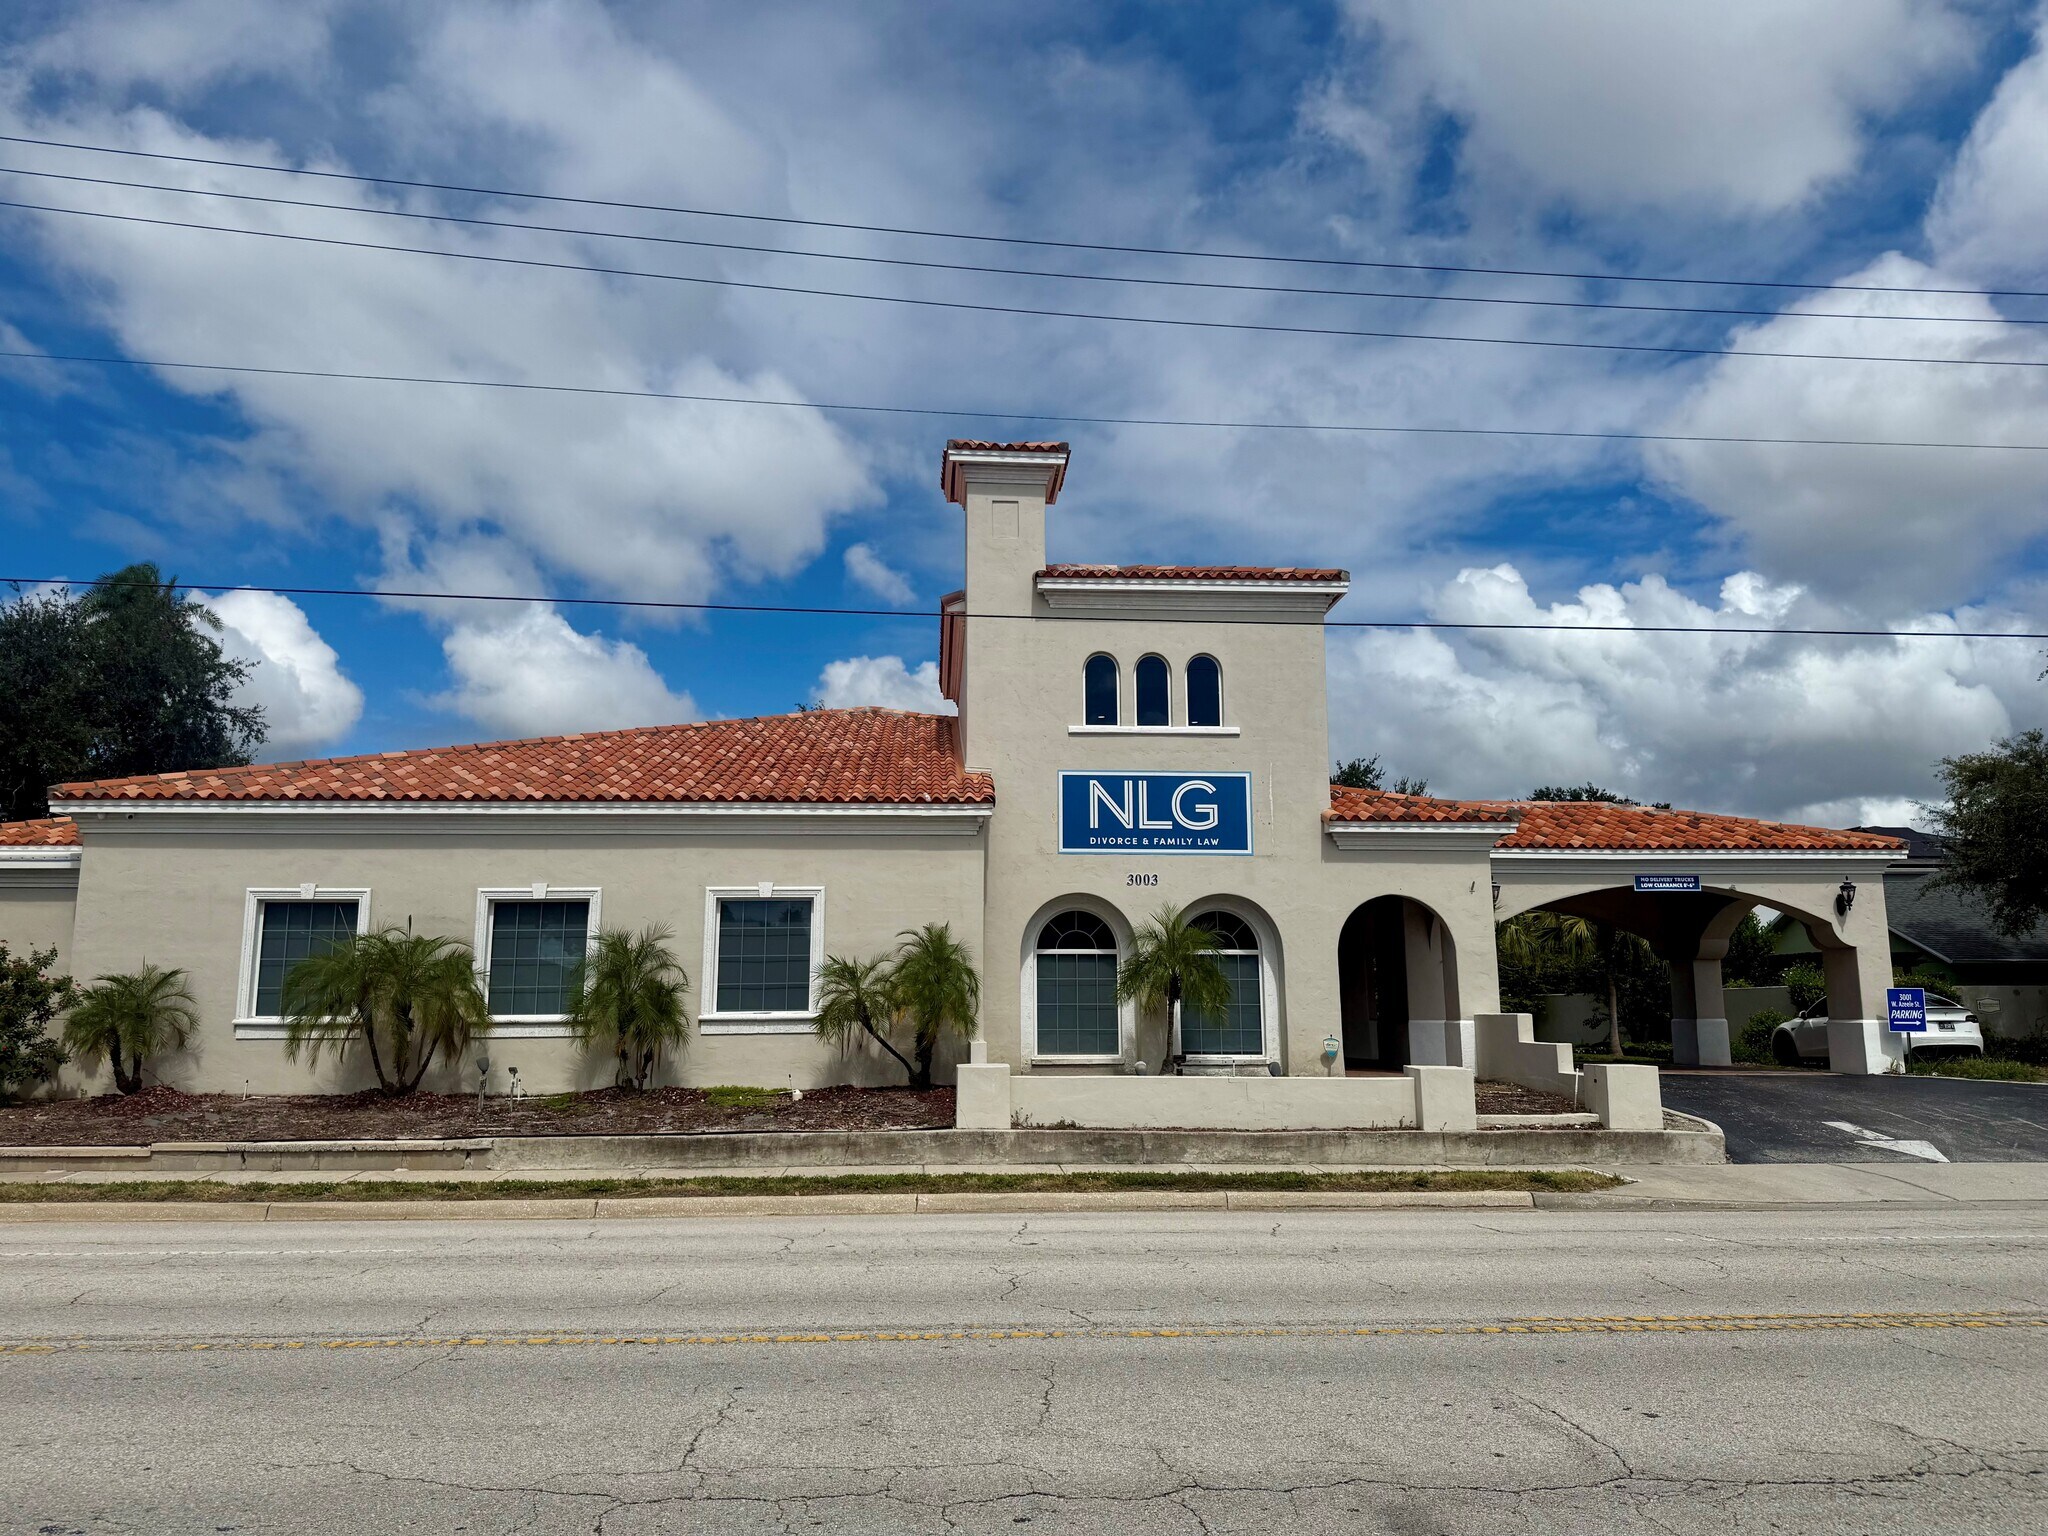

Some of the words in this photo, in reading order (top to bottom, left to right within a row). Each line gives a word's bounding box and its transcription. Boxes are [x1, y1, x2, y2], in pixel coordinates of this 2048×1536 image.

[1089, 780, 1219, 831] NLG
[1090, 837, 1138, 845] DIVORCE
[1142, 837, 1149, 845] &
[1154, 837, 1193, 846] FAMILY
[1197, 838, 1219, 846] LAW
[1126, 874, 1159, 886] 3003
[1891, 1010, 1923, 1019] PARKING
